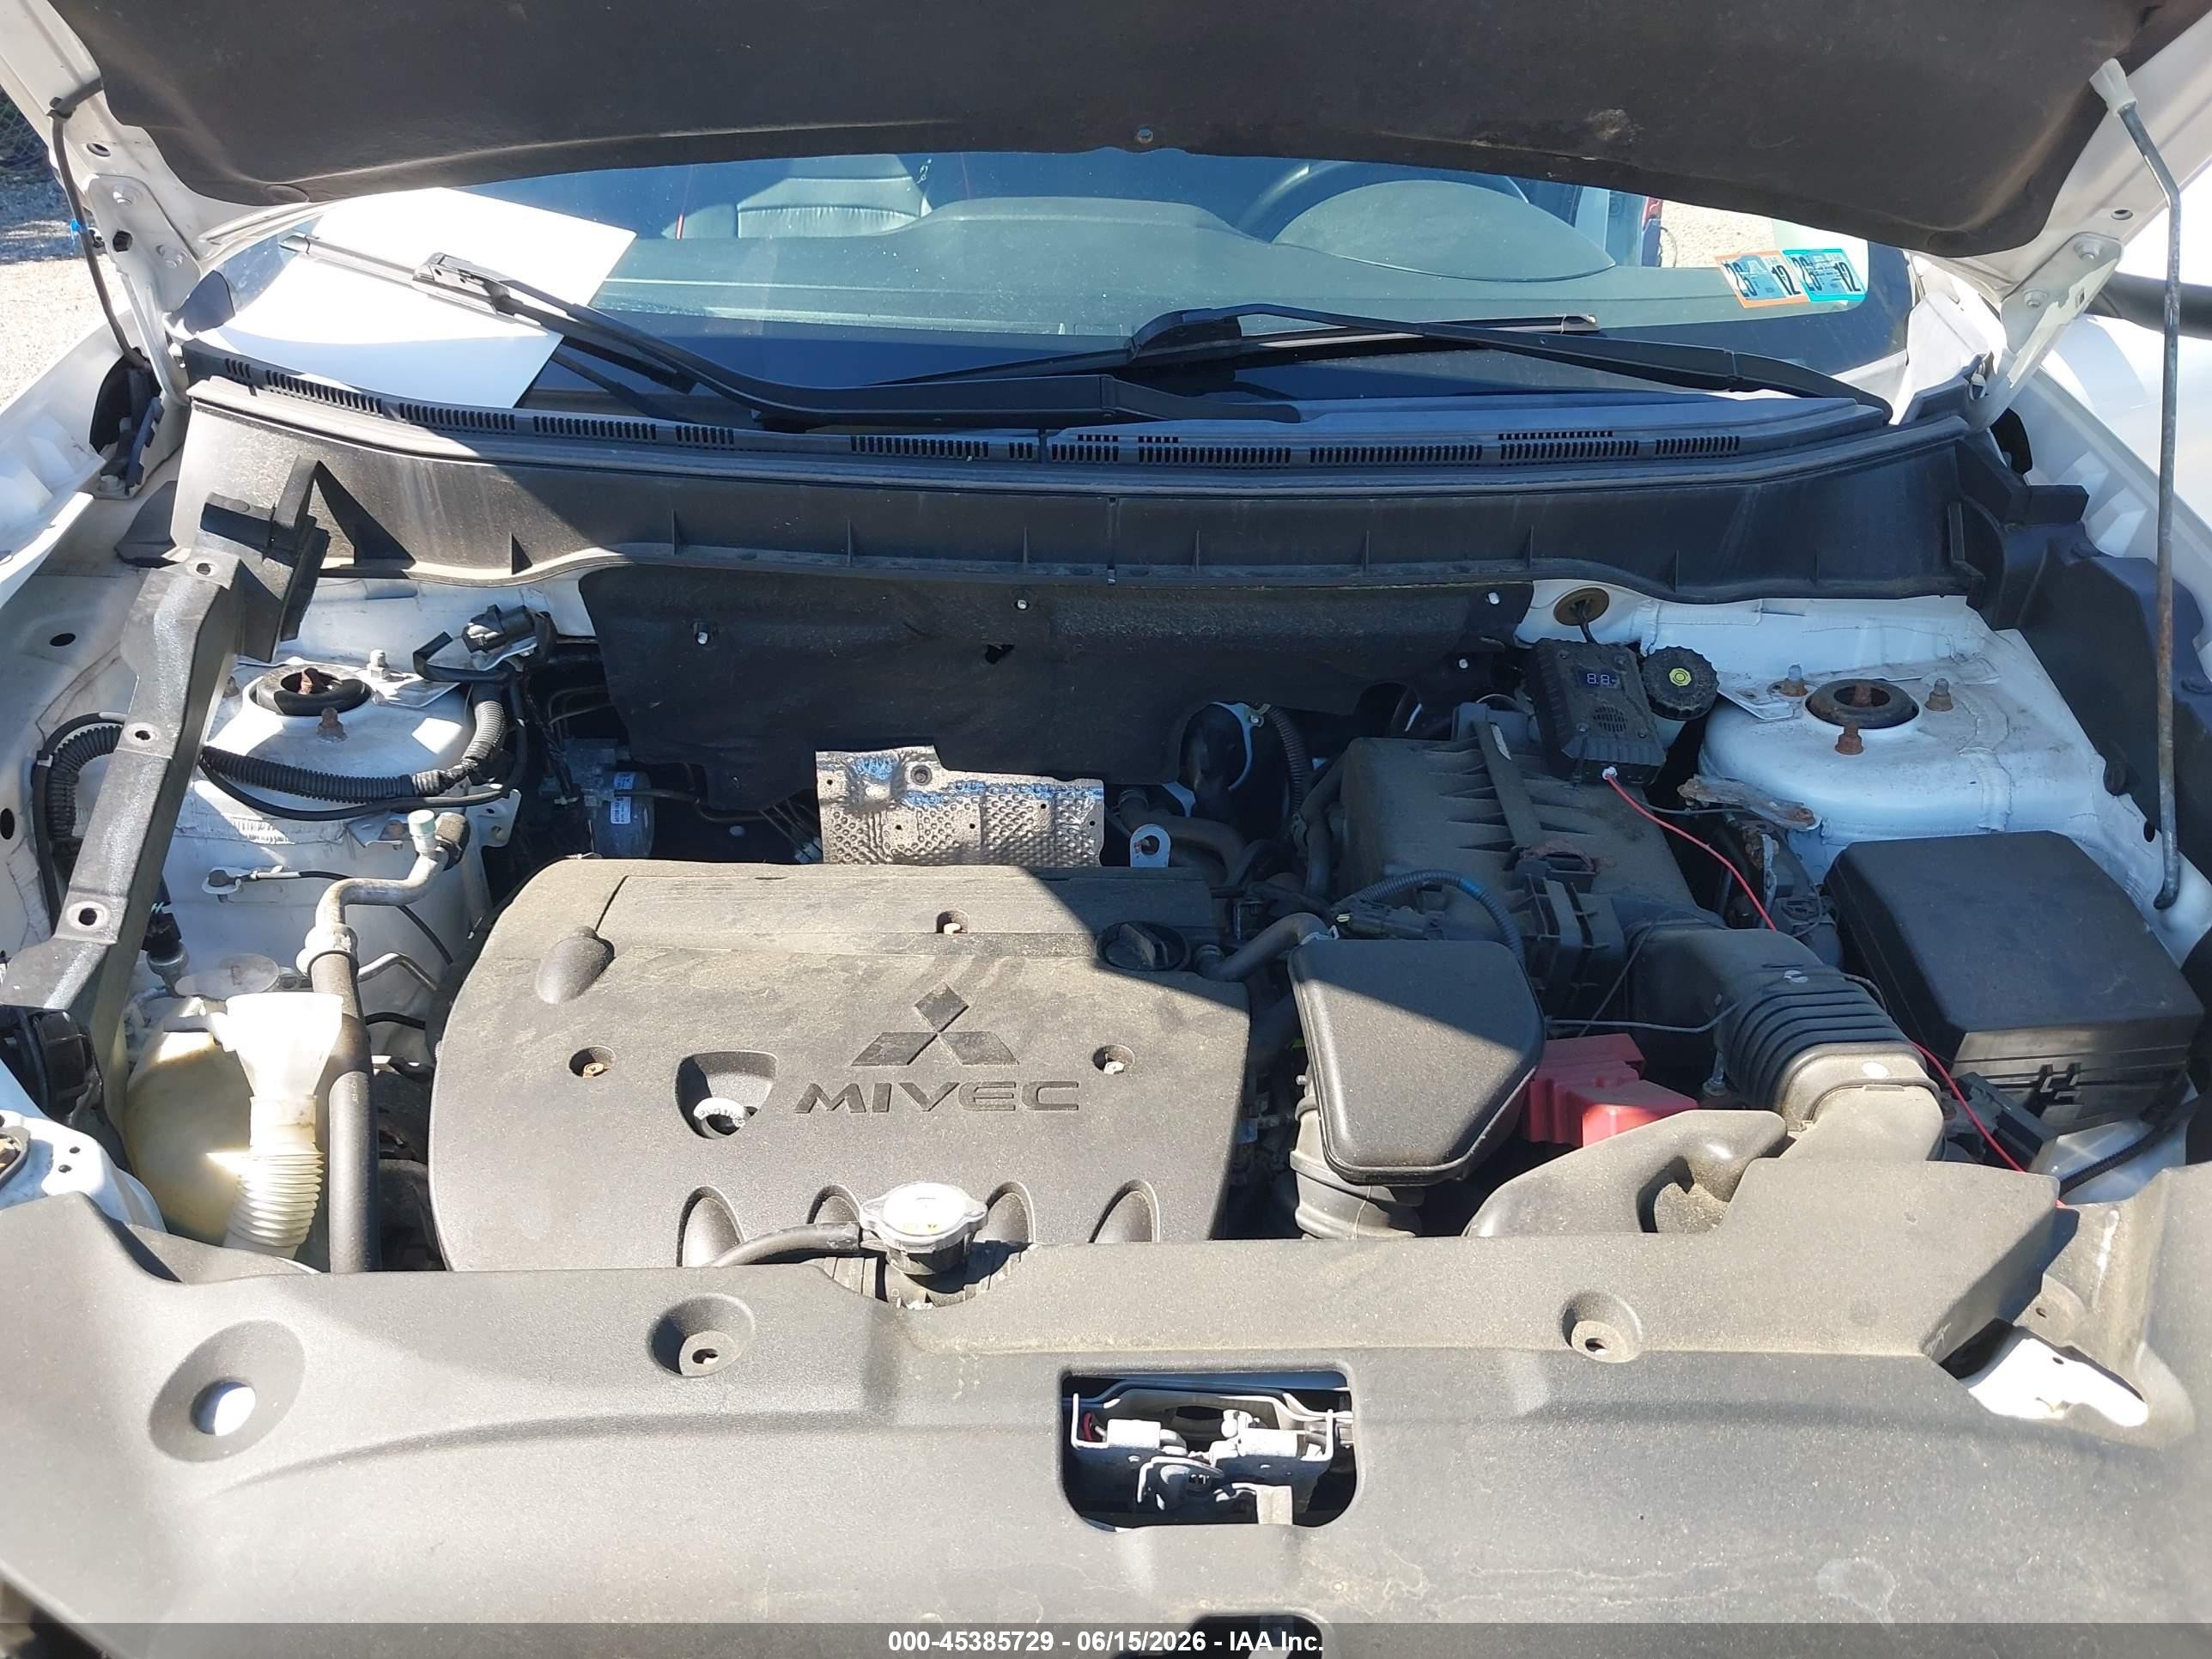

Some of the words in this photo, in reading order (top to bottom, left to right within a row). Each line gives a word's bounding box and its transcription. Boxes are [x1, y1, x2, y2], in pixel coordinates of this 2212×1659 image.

[1771, 264, 1802, 296] 12
[1832, 261, 1862, 293] 12
[793, 1081, 1079, 1114] MIVEC
